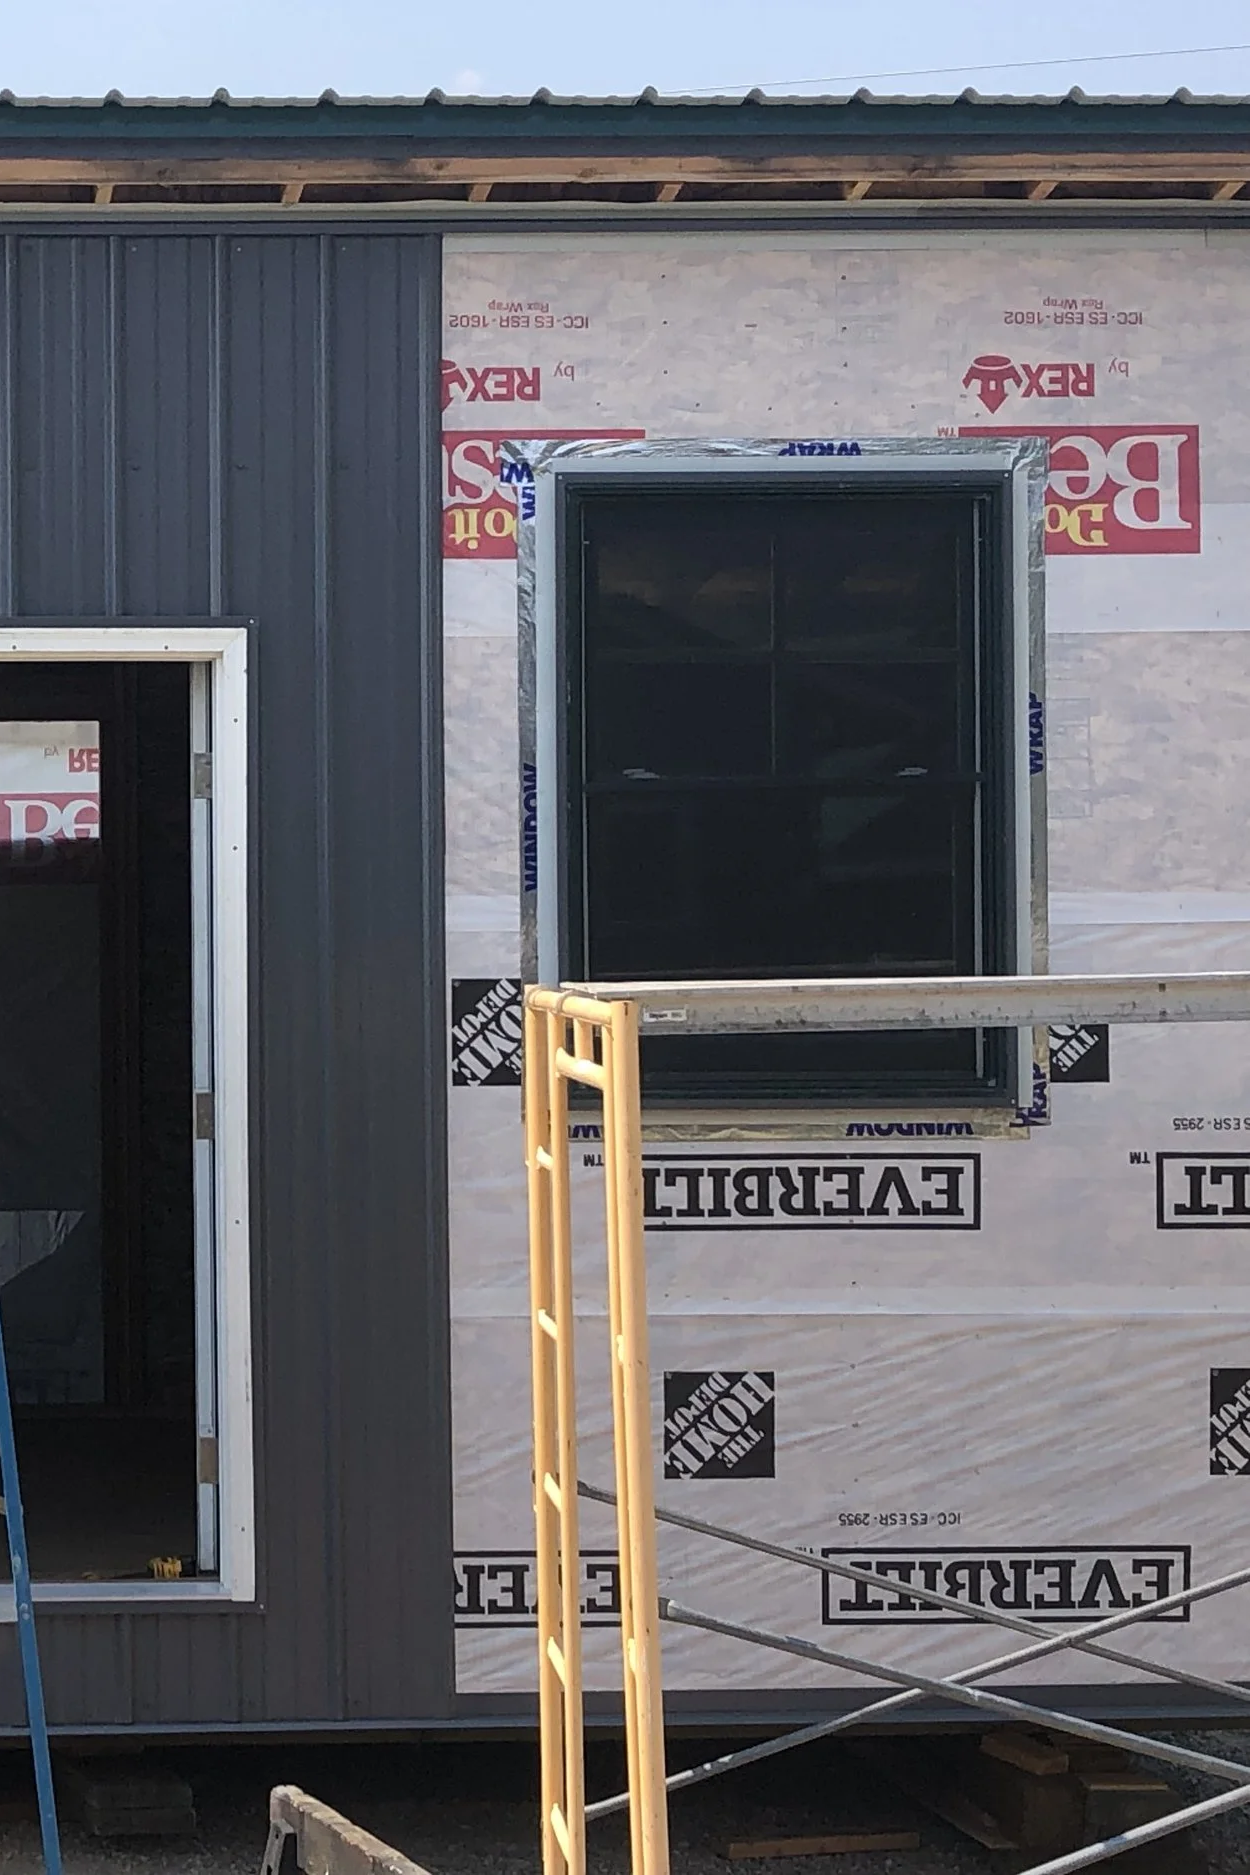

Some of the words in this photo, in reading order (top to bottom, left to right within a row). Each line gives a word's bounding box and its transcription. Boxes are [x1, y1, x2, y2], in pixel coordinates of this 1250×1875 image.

[466, 367, 541, 401] REX
[553, 361, 575, 381] by
[1020, 363, 1095, 398] REX
[1108, 357, 1129, 377] by
[1052, 1028, 1100, 1072] THE
[642, 1165, 965, 1218] EVERBILT
[664, 1372, 731, 1440] DEPOT
[664, 1372, 775, 1480] HOME
[717, 1424, 765, 1469] THE
